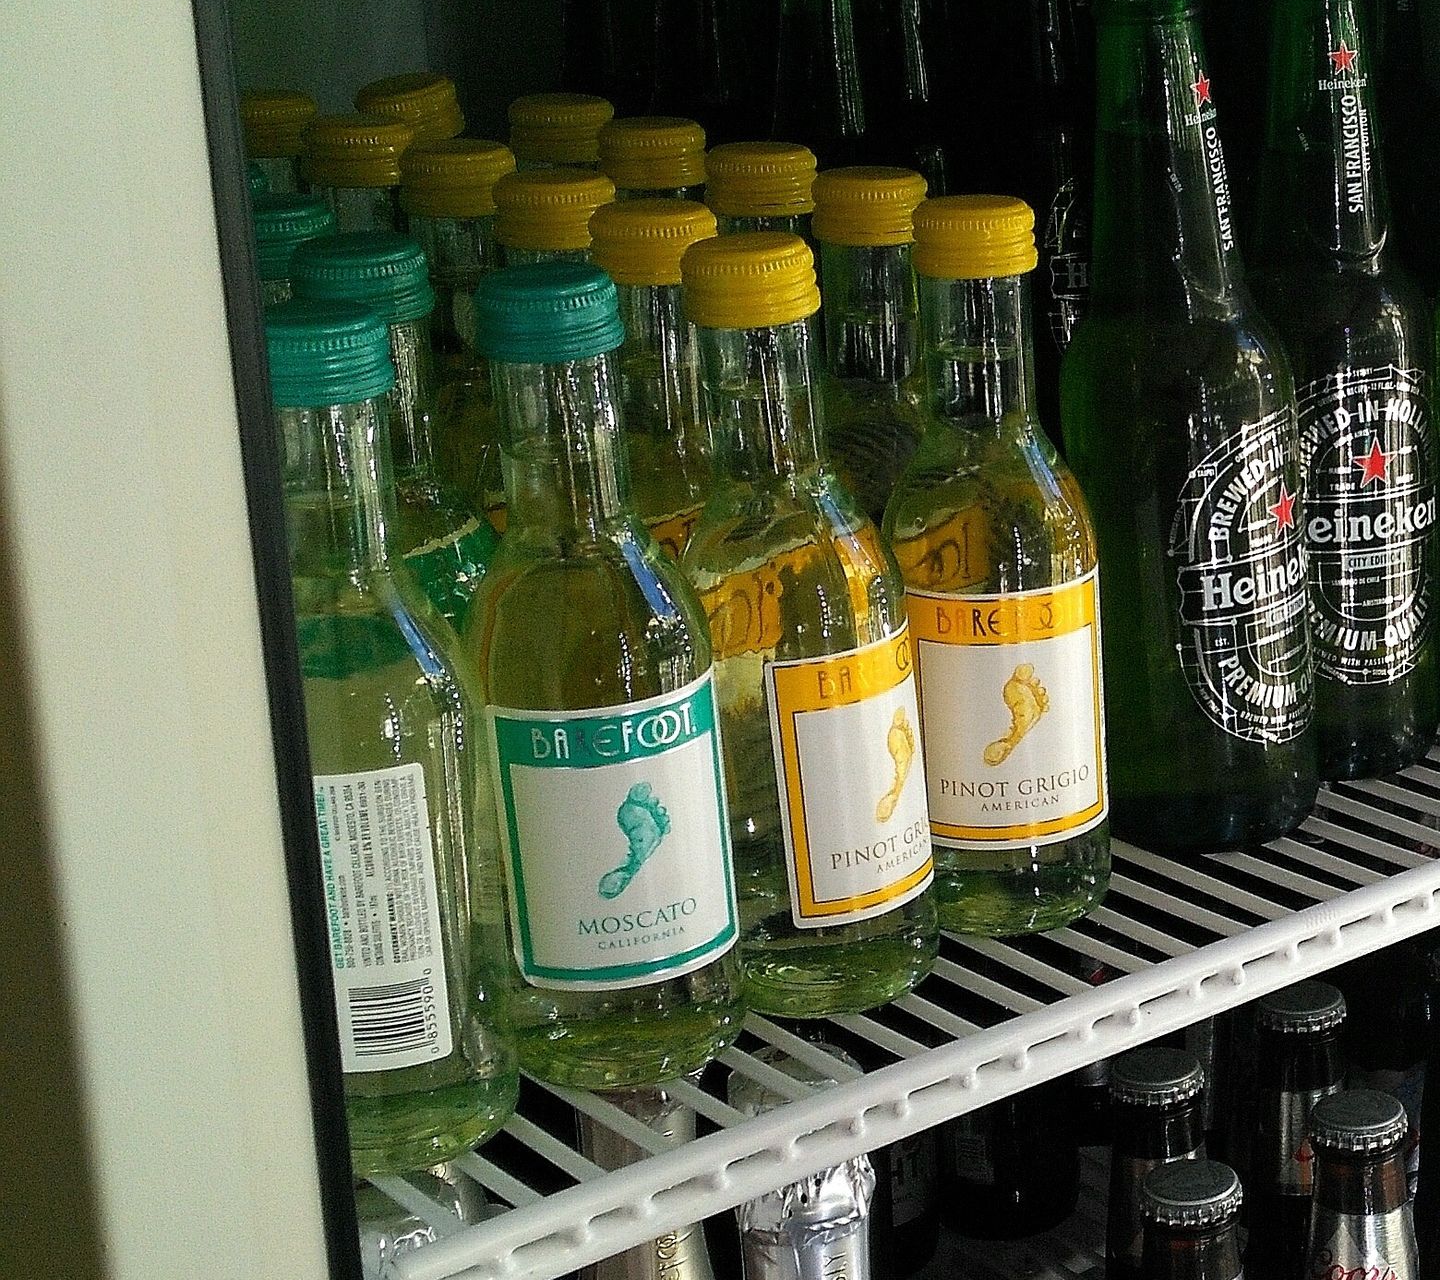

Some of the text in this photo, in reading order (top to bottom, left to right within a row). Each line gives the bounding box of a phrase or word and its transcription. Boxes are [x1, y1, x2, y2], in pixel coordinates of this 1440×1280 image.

[1205, 127, 1229, 216] FRANCISCO
[1341, 95, 1364, 213] SAN FRANCISCO
[1219, 217, 1234, 251] SAN
[1357, 399, 1379, 423] IN
[1208, 444, 1284, 541] BREWED IN
[1307, 496, 1436, 543] eineken
[1348, 556, 1368, 568] CITY
[1217, 655, 1298, 709] PREMIUM
[940, 764, 1090, 798] PINOT GRIGIO
[981, 793, 1060, 812] AMERICAN
[831, 835, 898, 870] PINOT
[577, 898, 697, 936] MOSCATO
[599, 924, 687, 950] CALIFORNIA
[422, 985, 439, 1039] 855590
